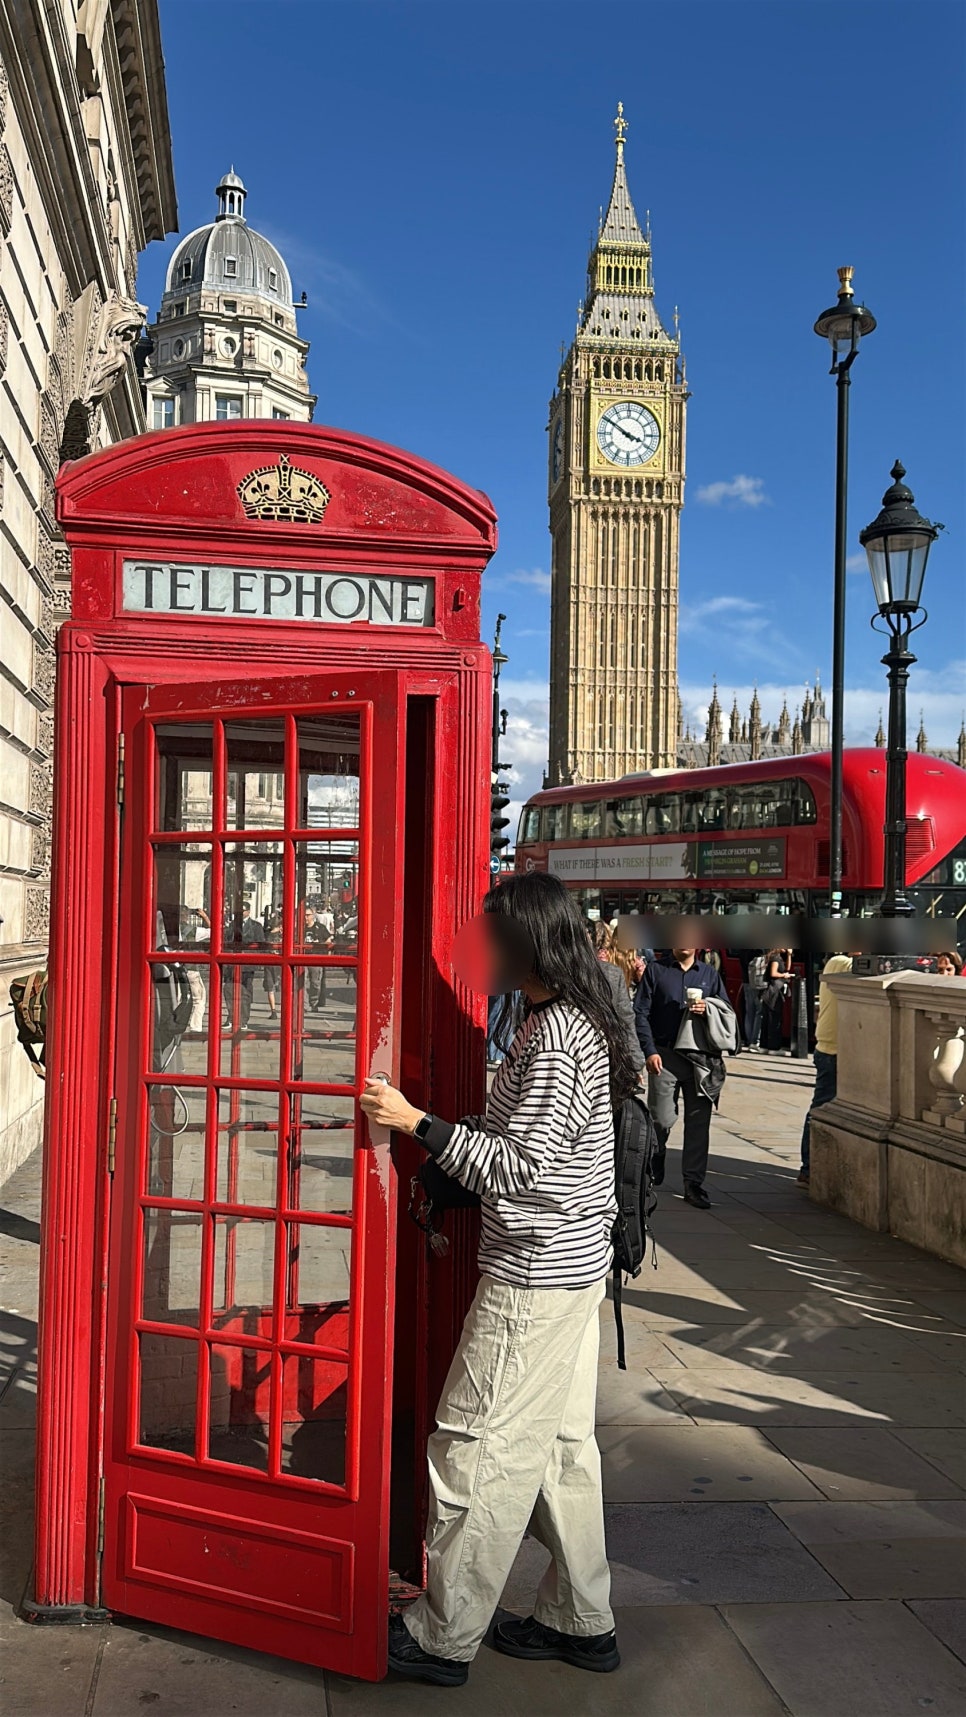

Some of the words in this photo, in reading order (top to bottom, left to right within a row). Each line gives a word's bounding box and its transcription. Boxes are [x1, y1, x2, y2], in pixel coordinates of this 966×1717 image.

[134, 566, 424, 623] TELEPHONE
[553, 859, 571, 870] WHAT
[572, 859, 579, 870] IF
[579, 859, 599, 870] THERE
[600, 858, 615, 868] WAS
[615, 858, 621, 868] A
[622, 857, 646, 868] FRESH
[646, 856, 673, 867] START?
[954, 860, 966, 882] 8
